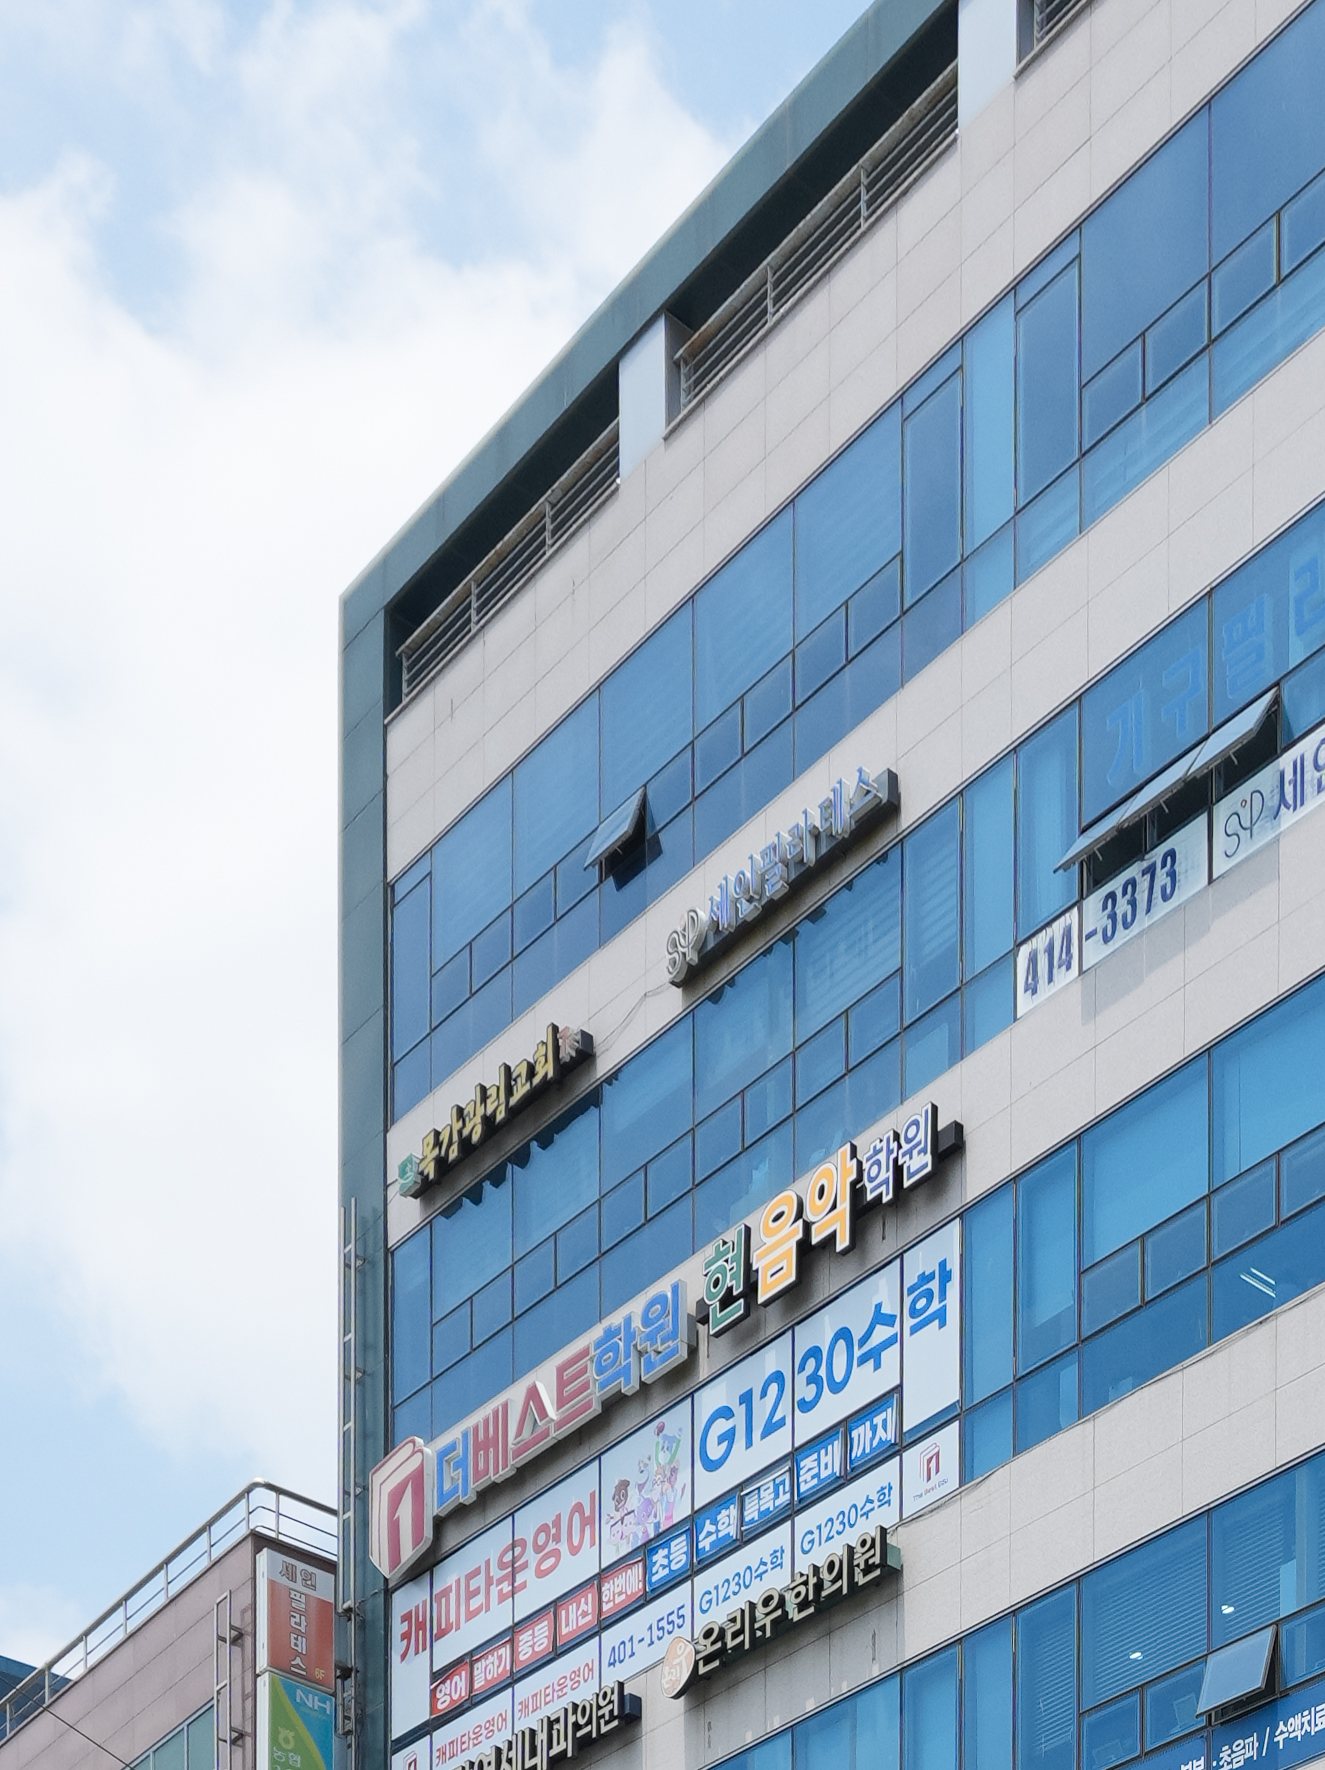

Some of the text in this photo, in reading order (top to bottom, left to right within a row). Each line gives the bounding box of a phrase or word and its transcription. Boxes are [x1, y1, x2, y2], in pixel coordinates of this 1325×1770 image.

[419, 1022, 560, 1181] 목감광림교회
[435, 1279, 690, 1517] 더베스트학원
[699, 1258, 952, 1474] G1230수학
[435, 1670, 466, 1710] 영어
[473, 1650, 510, 1692] 말하기
[518, 1621, 550, 1661] 중등
[560, 1593, 593, 1636] 내신
[651, 1540, 688, 1583] 초등
[698, 1499, 738, 1550] 수학
[799, 1438, 842, 1491] 준비
[851, 1403, 897, 1460] 까지
[800, 1482, 893, 1555] G1230수학
[280, 1559, 317, 1592] 세인
[400, 1489, 597, 1664] 캐피타운영어
[696, 1525, 888, 1675] 온리우한의원
[289, 1588, 308, 1678] 필라테스
[314, 1665, 325, 1681] 6F
[607, 1602, 687, 1668] 401-1555
[295, 1687, 331, 1715] NH
[517, 1658, 595, 1720] 캐피타운영어
